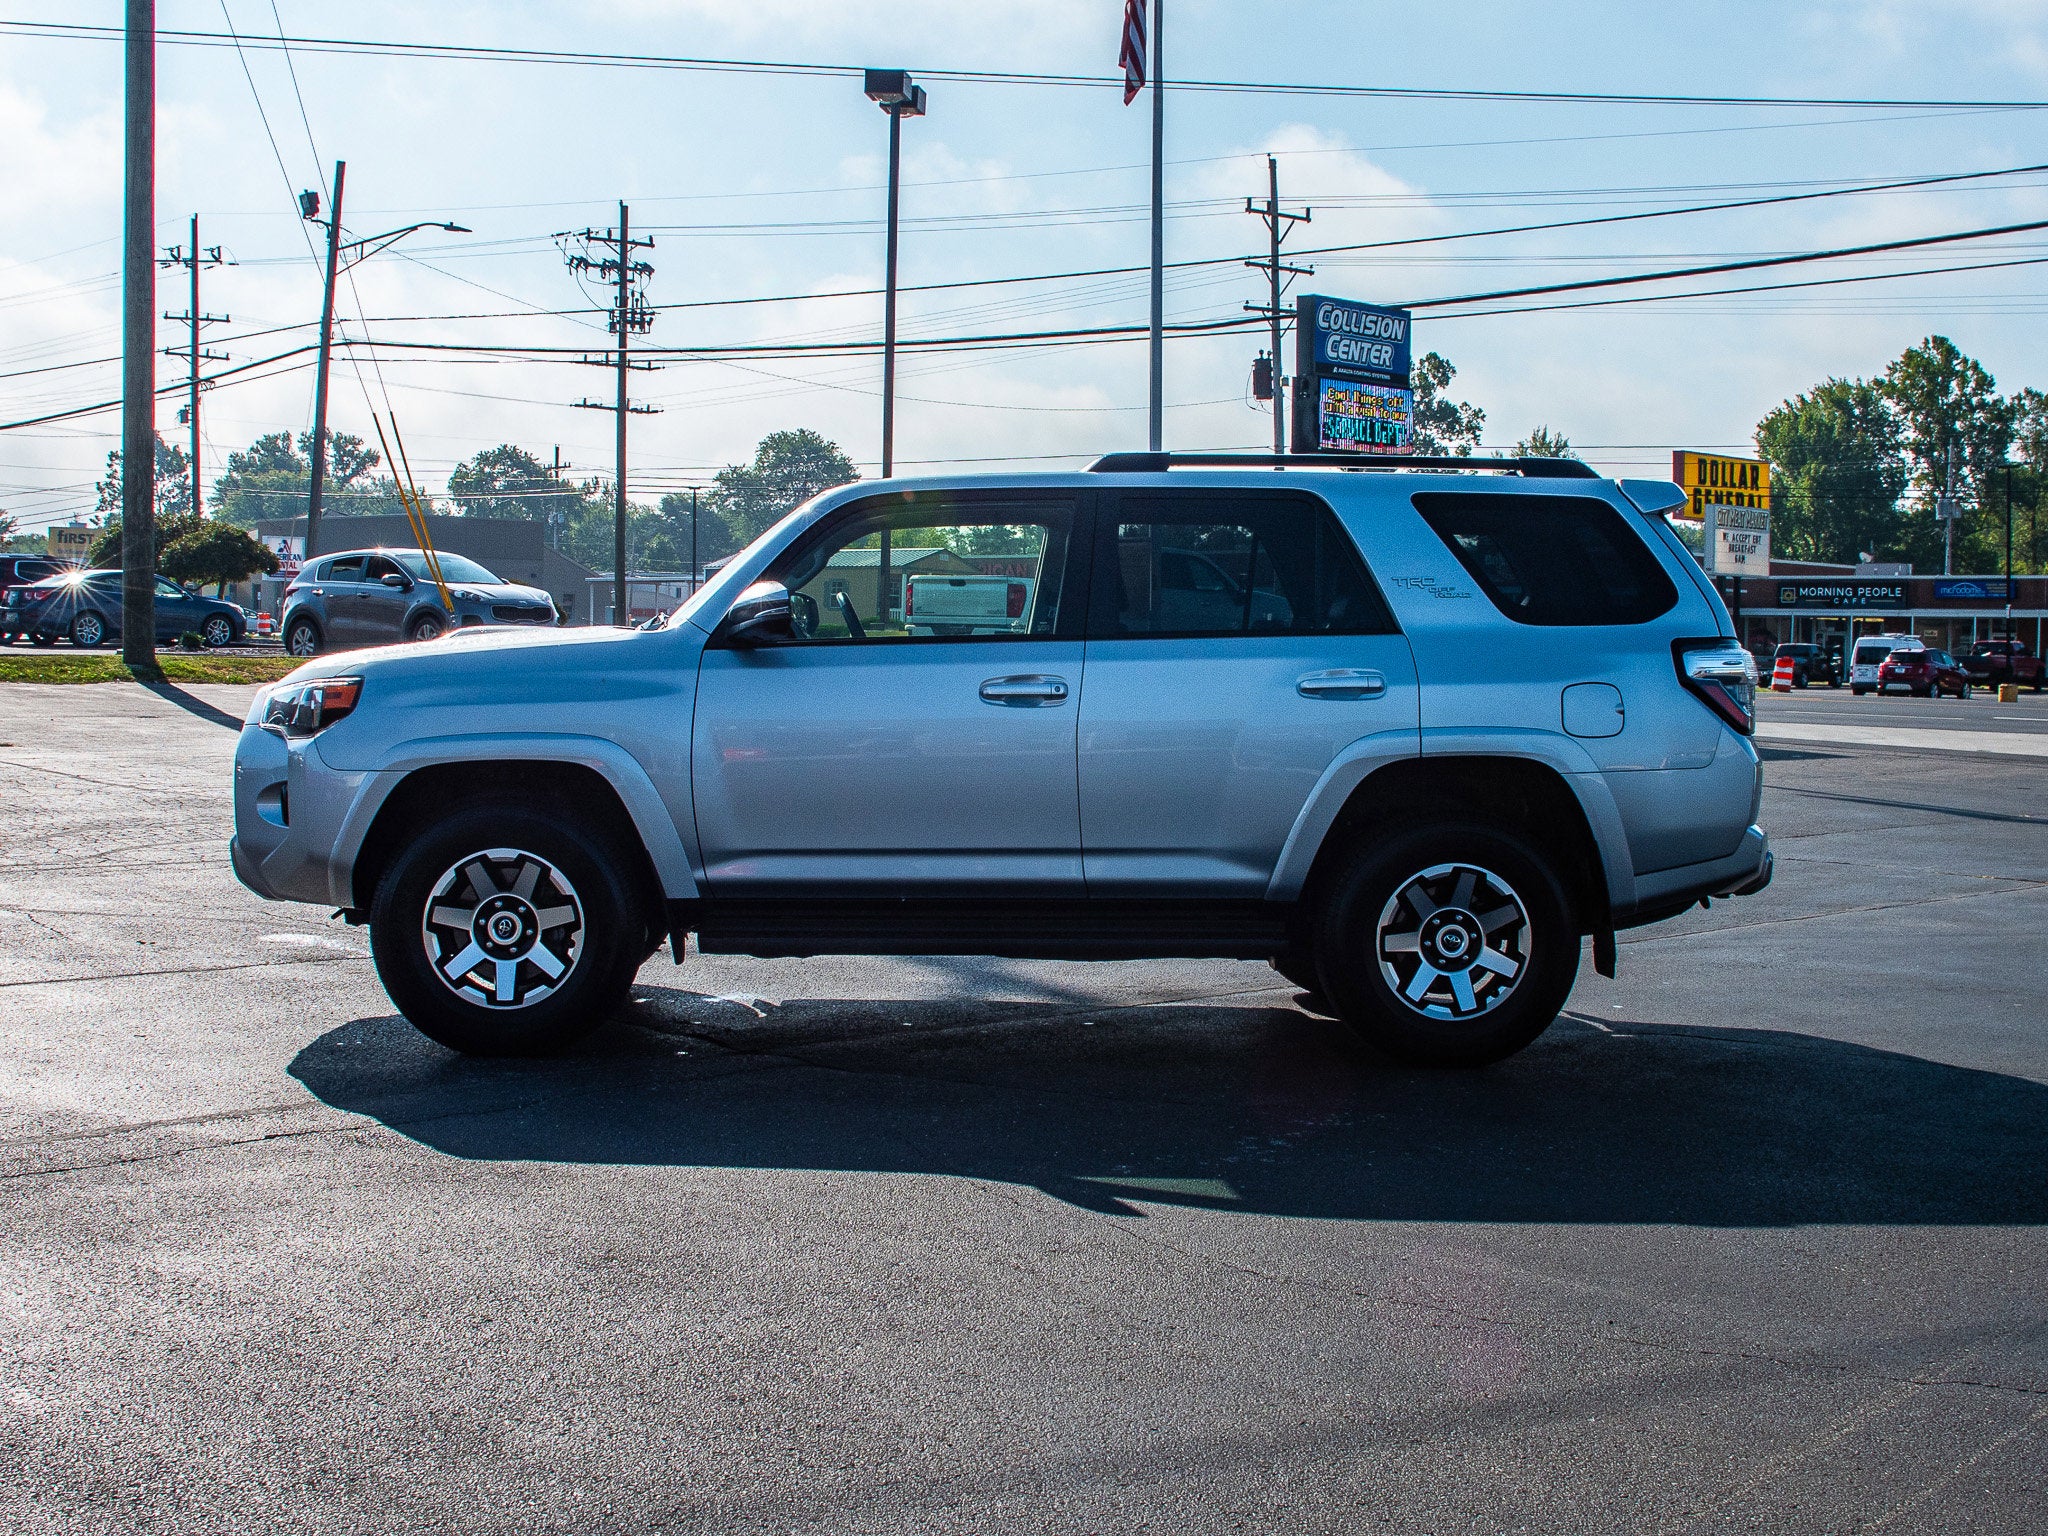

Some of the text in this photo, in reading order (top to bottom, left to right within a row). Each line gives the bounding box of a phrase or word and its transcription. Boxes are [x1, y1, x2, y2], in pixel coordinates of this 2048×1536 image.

[1317, 303, 1406, 342] COLLISION
[1326, 334, 1393, 369] CENTER
[1698, 458, 1760, 491] DOLLAR
[1717, 508, 1769, 531] CITY MEAT MARKET
[1732, 533, 1751, 543] ACCEPT
[1728, 543, 1757, 554] BREAKFAST
[1391, 577, 1436, 590] TRD
[1799, 587, 1902, 597] MORNING PEOPLE
[1833, 597, 1867, 605] CAFE
